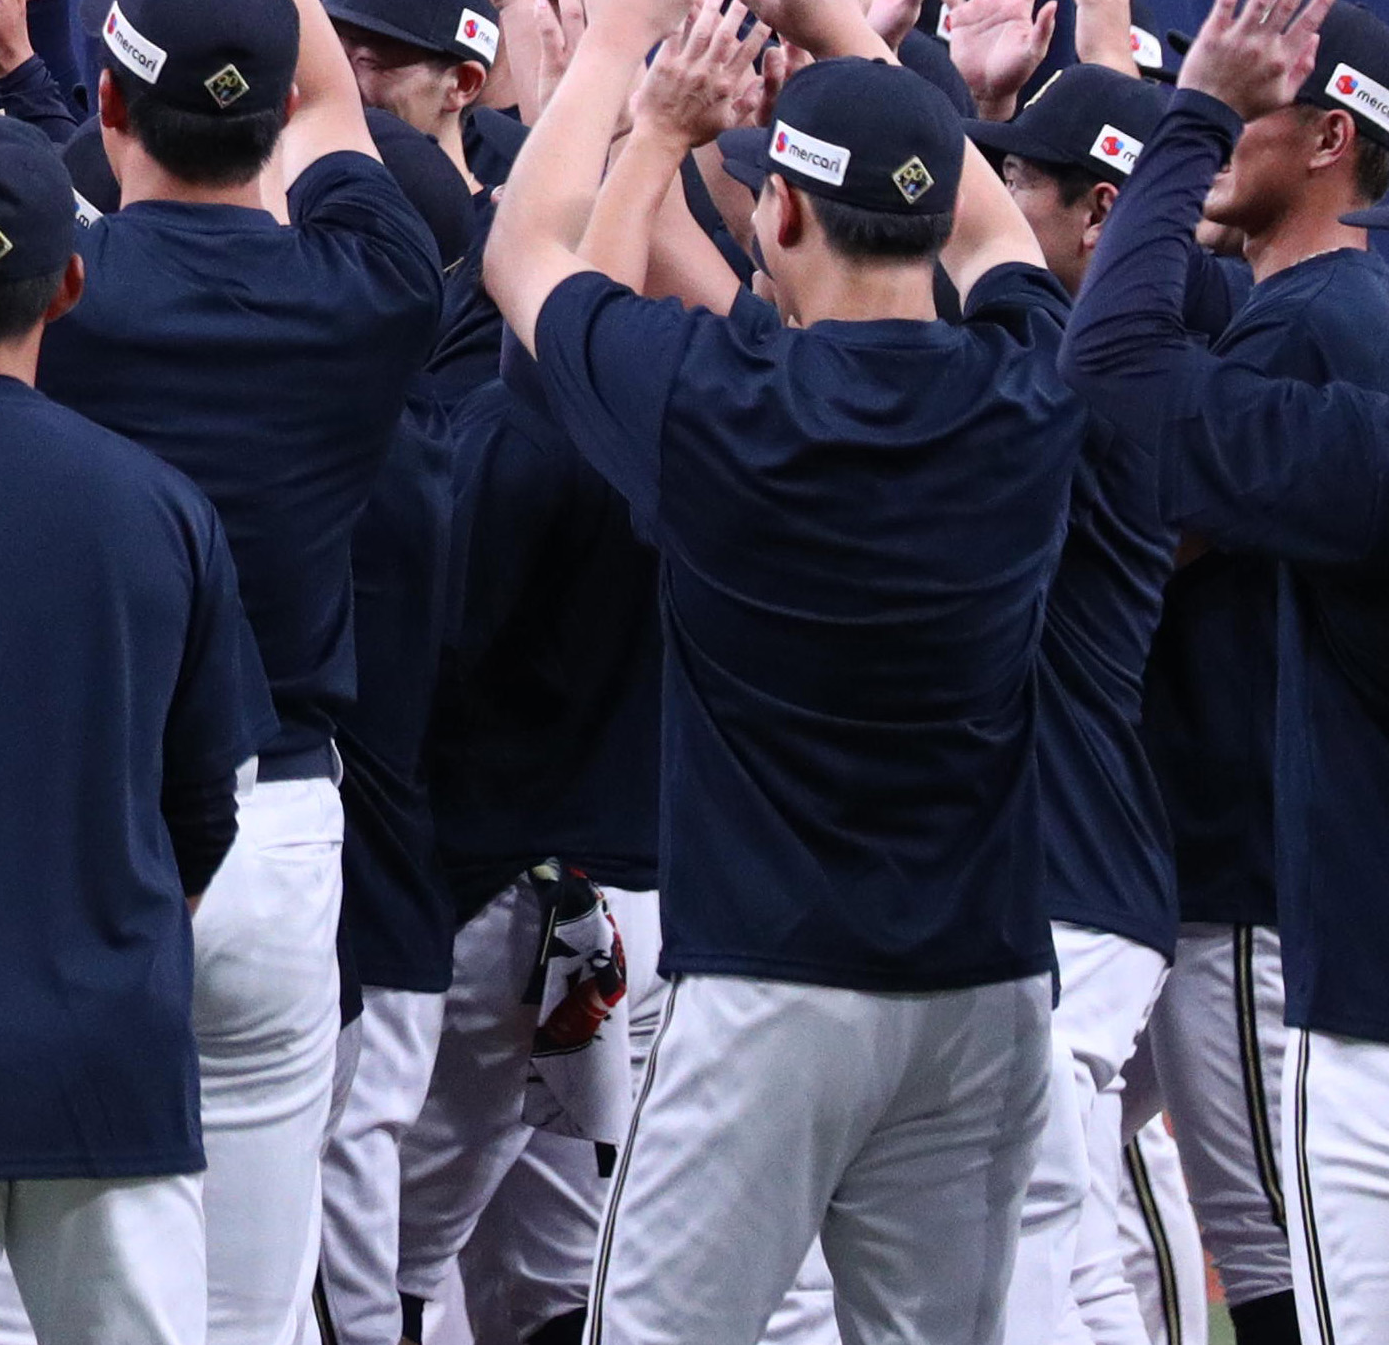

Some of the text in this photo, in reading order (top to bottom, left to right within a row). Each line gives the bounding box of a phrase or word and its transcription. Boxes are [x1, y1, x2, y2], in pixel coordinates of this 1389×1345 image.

[114, 30, 159, 73] mercari
[1356, 89, 1389, 117] merc
[788, 144, 842, 174] mercari
